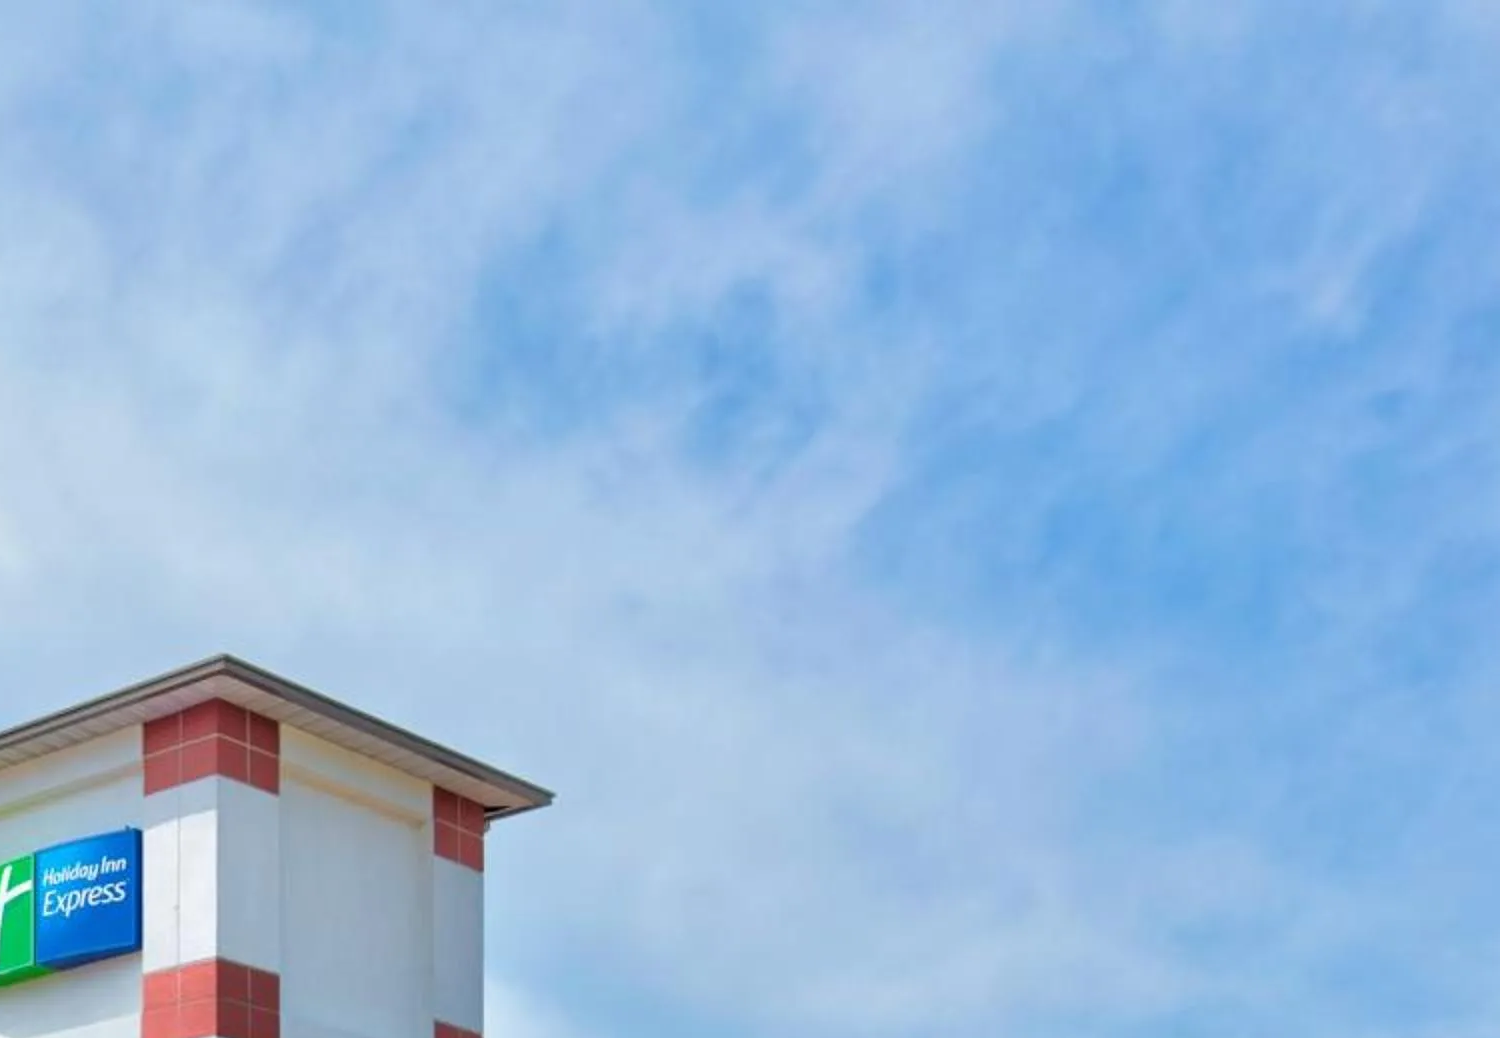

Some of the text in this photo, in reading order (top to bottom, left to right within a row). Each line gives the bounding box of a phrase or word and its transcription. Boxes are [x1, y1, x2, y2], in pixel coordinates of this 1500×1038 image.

[43, 856, 127, 887] Holiday Inn
[42, 881, 127, 917] Express
